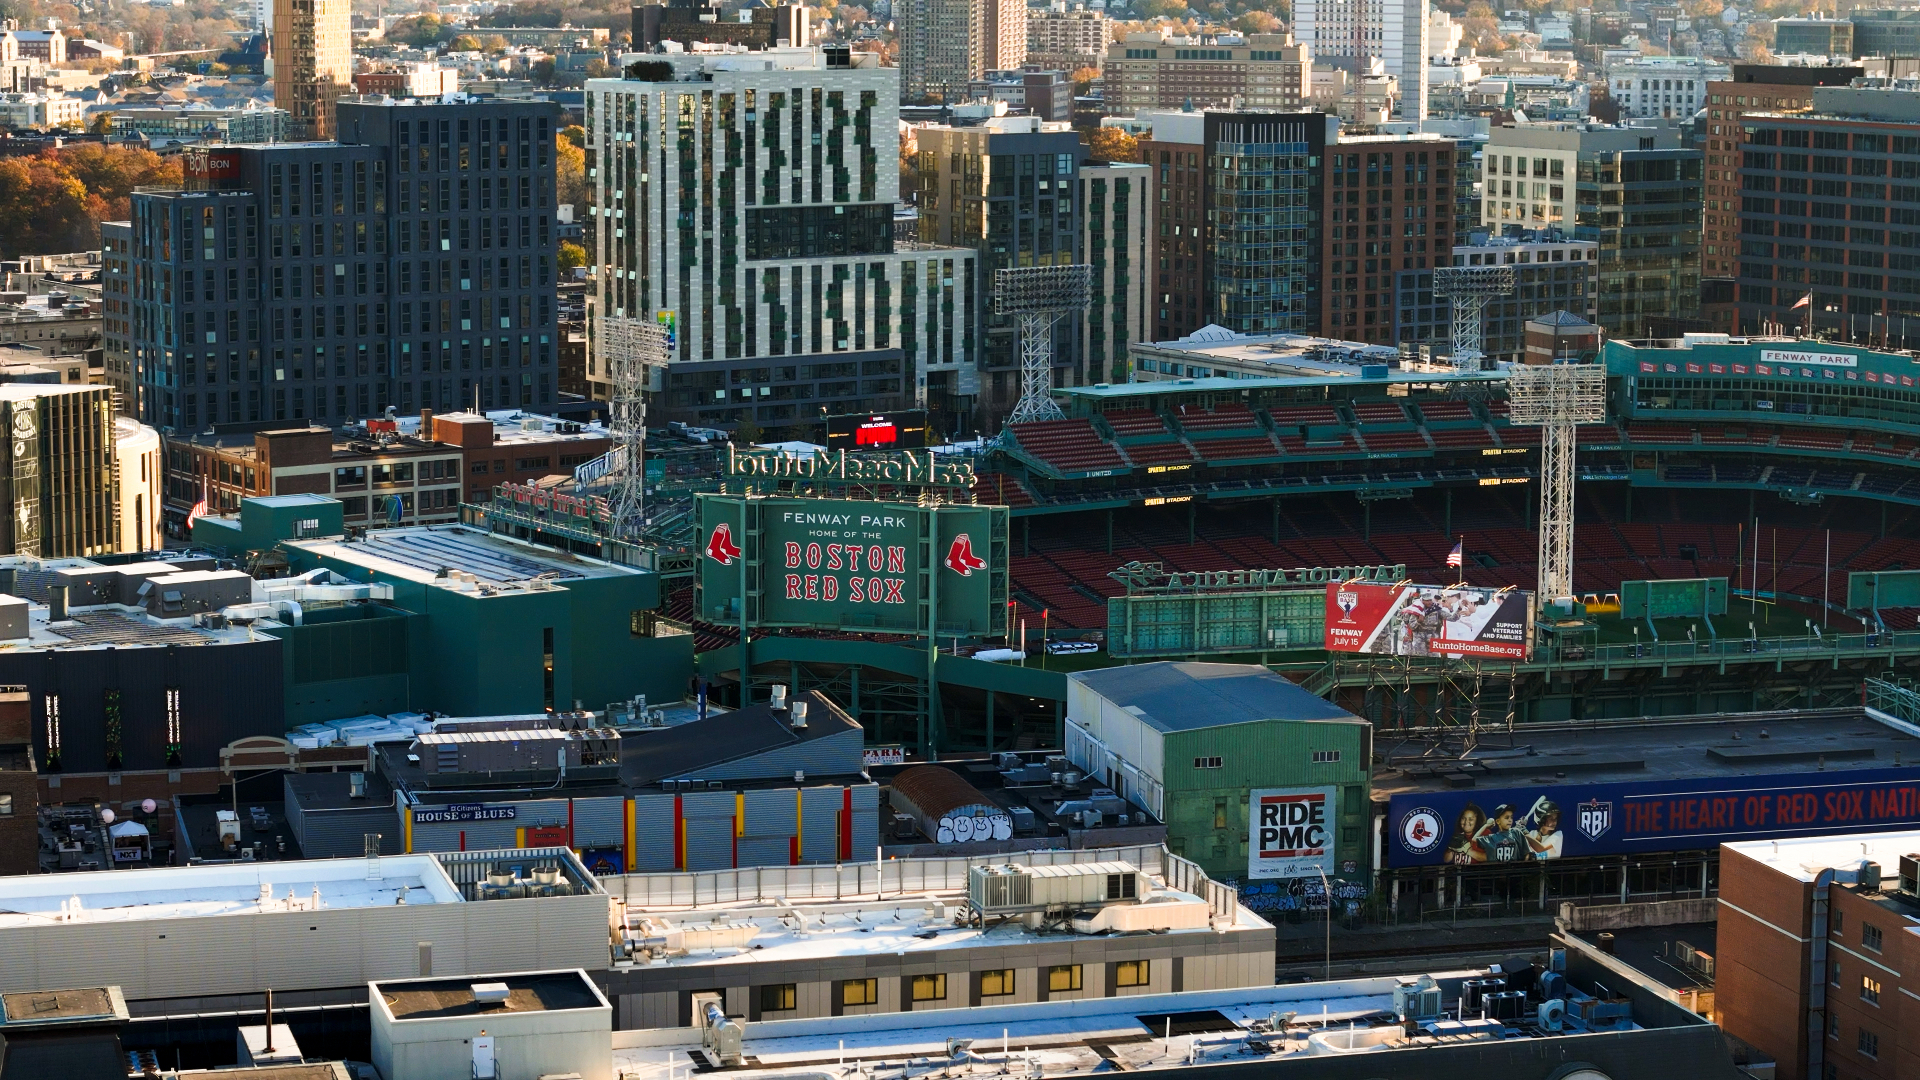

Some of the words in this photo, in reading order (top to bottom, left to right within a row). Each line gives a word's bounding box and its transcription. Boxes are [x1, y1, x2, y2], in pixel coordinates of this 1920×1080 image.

[1766, 352, 1813, 362] FENWAY
[1820, 355, 1851, 364] PARK
[12, 400, 36, 413] BOSTON
[1147, 466, 1166, 474] SPARTAN
[1479, 478, 1501, 486] SPARTAN
[1144, 498, 1165, 506] SPARTAN
[783, 512, 851, 525] FENWAY
[860, 515, 906, 528] PARK
[809, 530, 838, 538] HOME
[785, 541, 906, 573] BOSTON
[785, 573, 839, 601] RED
[849, 576, 906, 603] SOX
[1330, 628, 1363, 637] FENWAY
[1333, 637, 1349, 646] July
[1351, 638, 1359, 646] 15
[1432, 641, 1522, 656] RuntoHomeBase.org
[863, 748, 902, 757] PARK
[416, 812, 459, 822] HOUSE
[474, 809, 515, 819] BLUES
[1260, 802, 1325, 826] RIDE
[1623, 802, 1663, 833] THE
[1669, 797, 1739, 830] HEART
[1744, 796, 1771, 826] OF
[1777, 793, 1818, 824] RED
[1824, 790, 1864, 821] SOX
[1581, 811, 1608, 837] RBI
[1260, 825, 1325, 850] PMC
[1404, 841, 1438, 852] FOUNDATION
